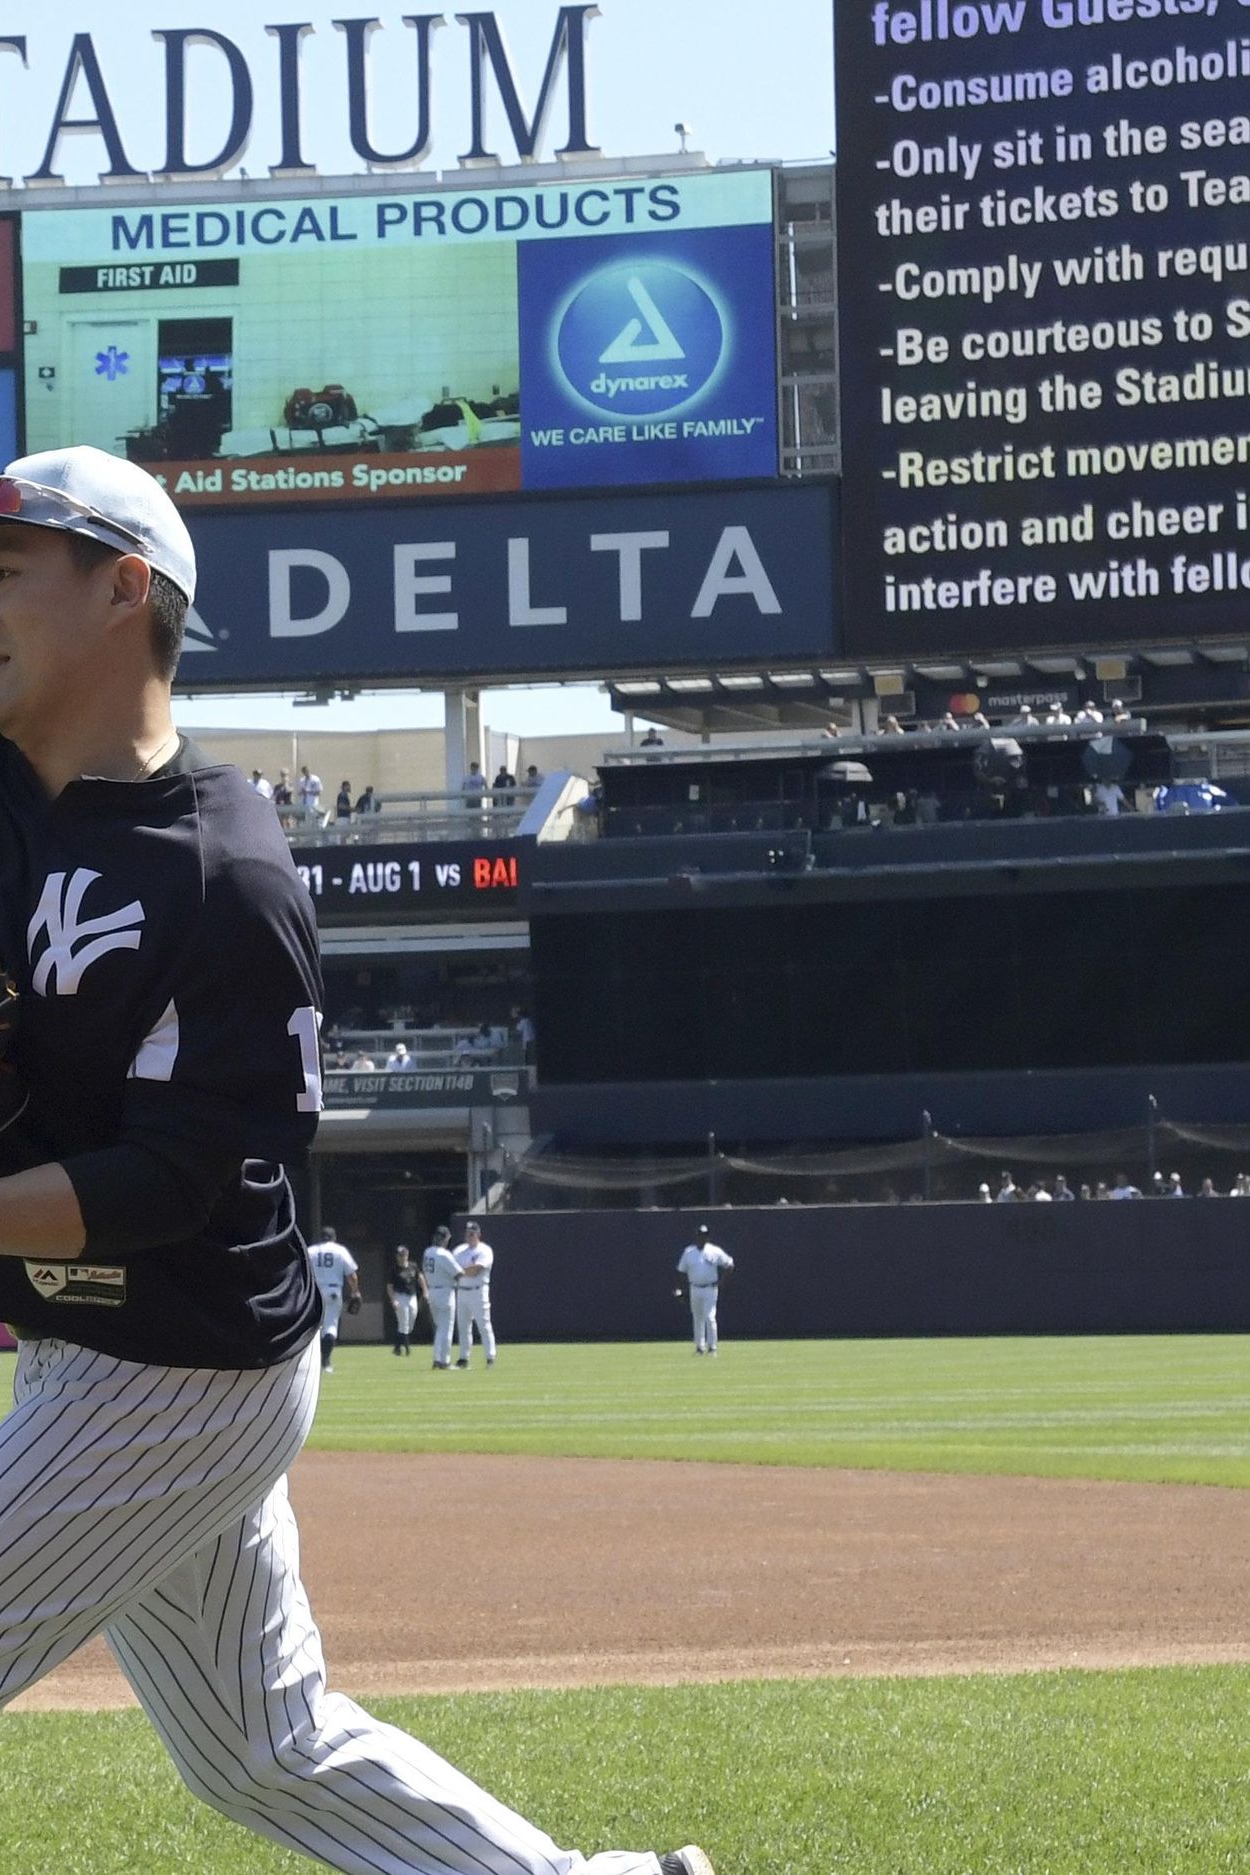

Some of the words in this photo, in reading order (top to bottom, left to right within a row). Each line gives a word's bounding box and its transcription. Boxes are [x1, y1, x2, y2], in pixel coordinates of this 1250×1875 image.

[872, 1, 1026, 46] fellow
[875, 67, 1073, 112] -Consume
[1086, 39, 1250, 93] alcoholi
[876, 136, 982, 180] -Only
[993, 129, 1044, 169] sit
[1055, 125, 1092, 162] in
[1104, 119, 1168, 157] the
[1180, 115, 1250, 150] sea
[111, 203, 356, 251] MEDICAL
[376, 184, 681, 239] PRODUCTS
[875, 194, 970, 237] their
[980, 186, 1119, 228] tickets
[1130, 180, 1168, 213] to
[1180, 169, 1250, 208] Tea
[97, 266, 154, 288] FIRST
[159, 264, 197, 284] AID
[878, 254, 1042, 303] -Comply
[1053, 243, 1144, 286] with
[1158, 242, 1248, 282] requ
[879, 327, 949, 366] -Be
[962, 314, 1164, 361] courteous
[1174, 310, 1213, 342] to
[590, 373, 688, 398] dynarex
[881, 381, 1028, 424] leaving
[1039, 374, 1102, 412] the
[531, 429, 565, 446] WE
[570, 426, 626, 445] CARE
[632, 422, 678, 442] LIKE
[175, 468, 223, 493] Aid
[231, 465, 345, 492] Stations
[353, 463, 467, 492] Sponsor
[882, 444, 1056, 489] -Restrict
[883, 513, 1008, 556] action
[1022, 504, 1094, 547] and
[1107, 500, 1224, 540] cheer
[268, 525, 783, 638] DELTA
[885, 569, 1057, 613] interfere
[1068, 560, 1159, 600] with
[988, 691, 1068, 706] masterpass
[348, 861, 401, 894] AUG
[408, 860, 420, 891] 1
[353, 1077, 386, 1093] VISIT
[388, 1075, 444, 1092] SECTION
